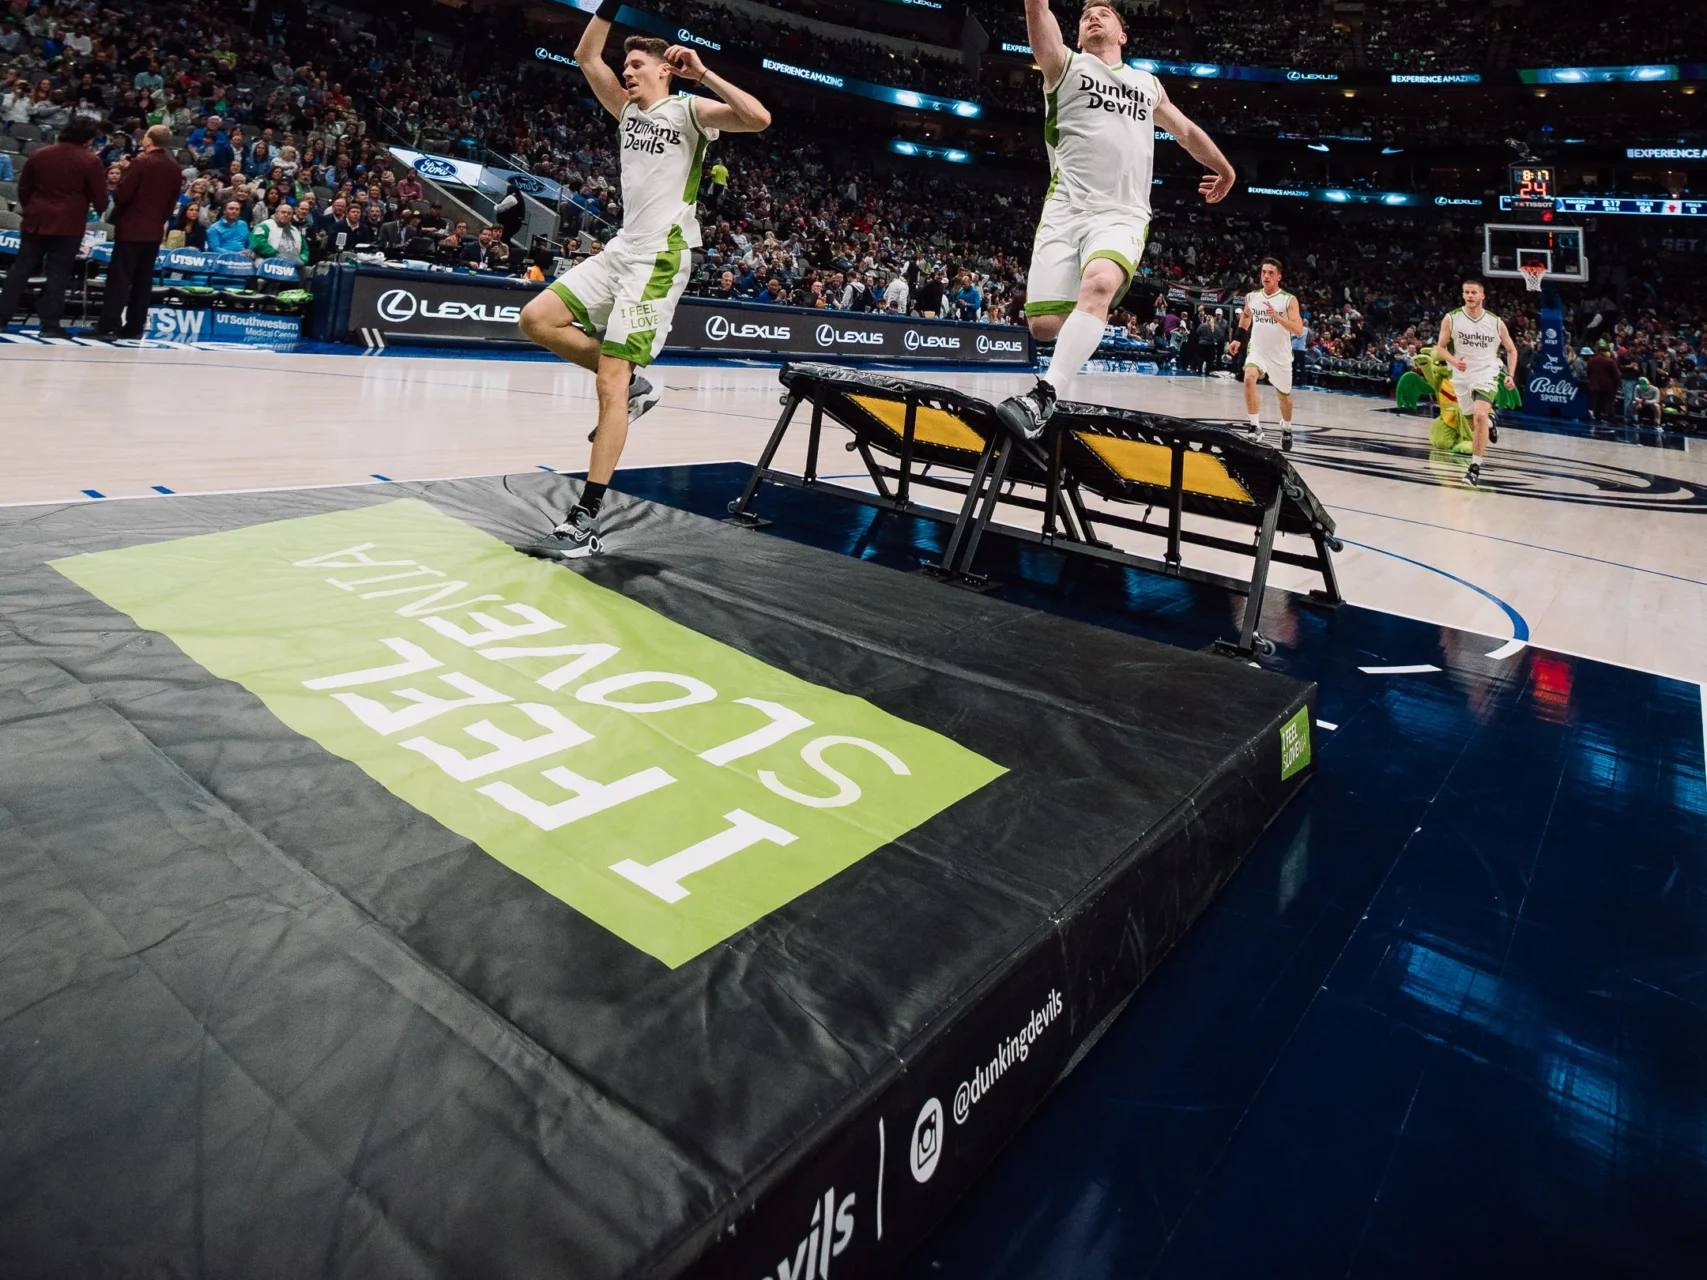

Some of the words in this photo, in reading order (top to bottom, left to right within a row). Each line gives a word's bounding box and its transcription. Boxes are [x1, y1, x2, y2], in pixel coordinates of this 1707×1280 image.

[690, 36, 721, 51] LEXUS
[767, 61, 810, 79] EXPERIENCE
[810, 70, 844, 88] AMAZING
[1301, 73, 1338, 81] LEXUS
[1396, 75, 1442, 83] EXPERIENCE
[1442, 75, 1481, 83] AMAZING
[1087, 93, 1147, 121] Devils
[626, 118, 680, 144] Dunking
[624, 134, 664, 155] Devils
[1635, 149, 1700, 158] EXPERIENCE
[420, 158, 450, 176] Ford
[1523, 170, 1549, 180] 8:17
[1520, 181, 1547, 198] 24
[1448, 198, 1483, 206] LEXUS
[171, 254, 205, 266] UTSW
[264, 263, 295, 276] UTSW
[420, 300, 521, 323] LEXUS
[629, 304, 656, 317] FEEL
[245, 328, 273, 337] Medical
[274, 330, 298, 339] Center
[730, 322, 790, 340] LEXUS
[836, 330, 884, 345] LEXUS
[920, 335, 960, 349] LEXUS
[989, 340, 1022, 352] LEXUS
[1463, 339, 1488, 349] Devils
[1530, 377, 1578, 400] Bally
[1540, 395, 1567, 403] SPORTS
[291, 542, 913, 808] SLOVENIA
[302, 638, 678, 831] FEEL
[1285, 722, 1298, 748] FEEL
[608, 808, 799, 904] I
[953, 988, 1063, 1125] @dunkingdevils
